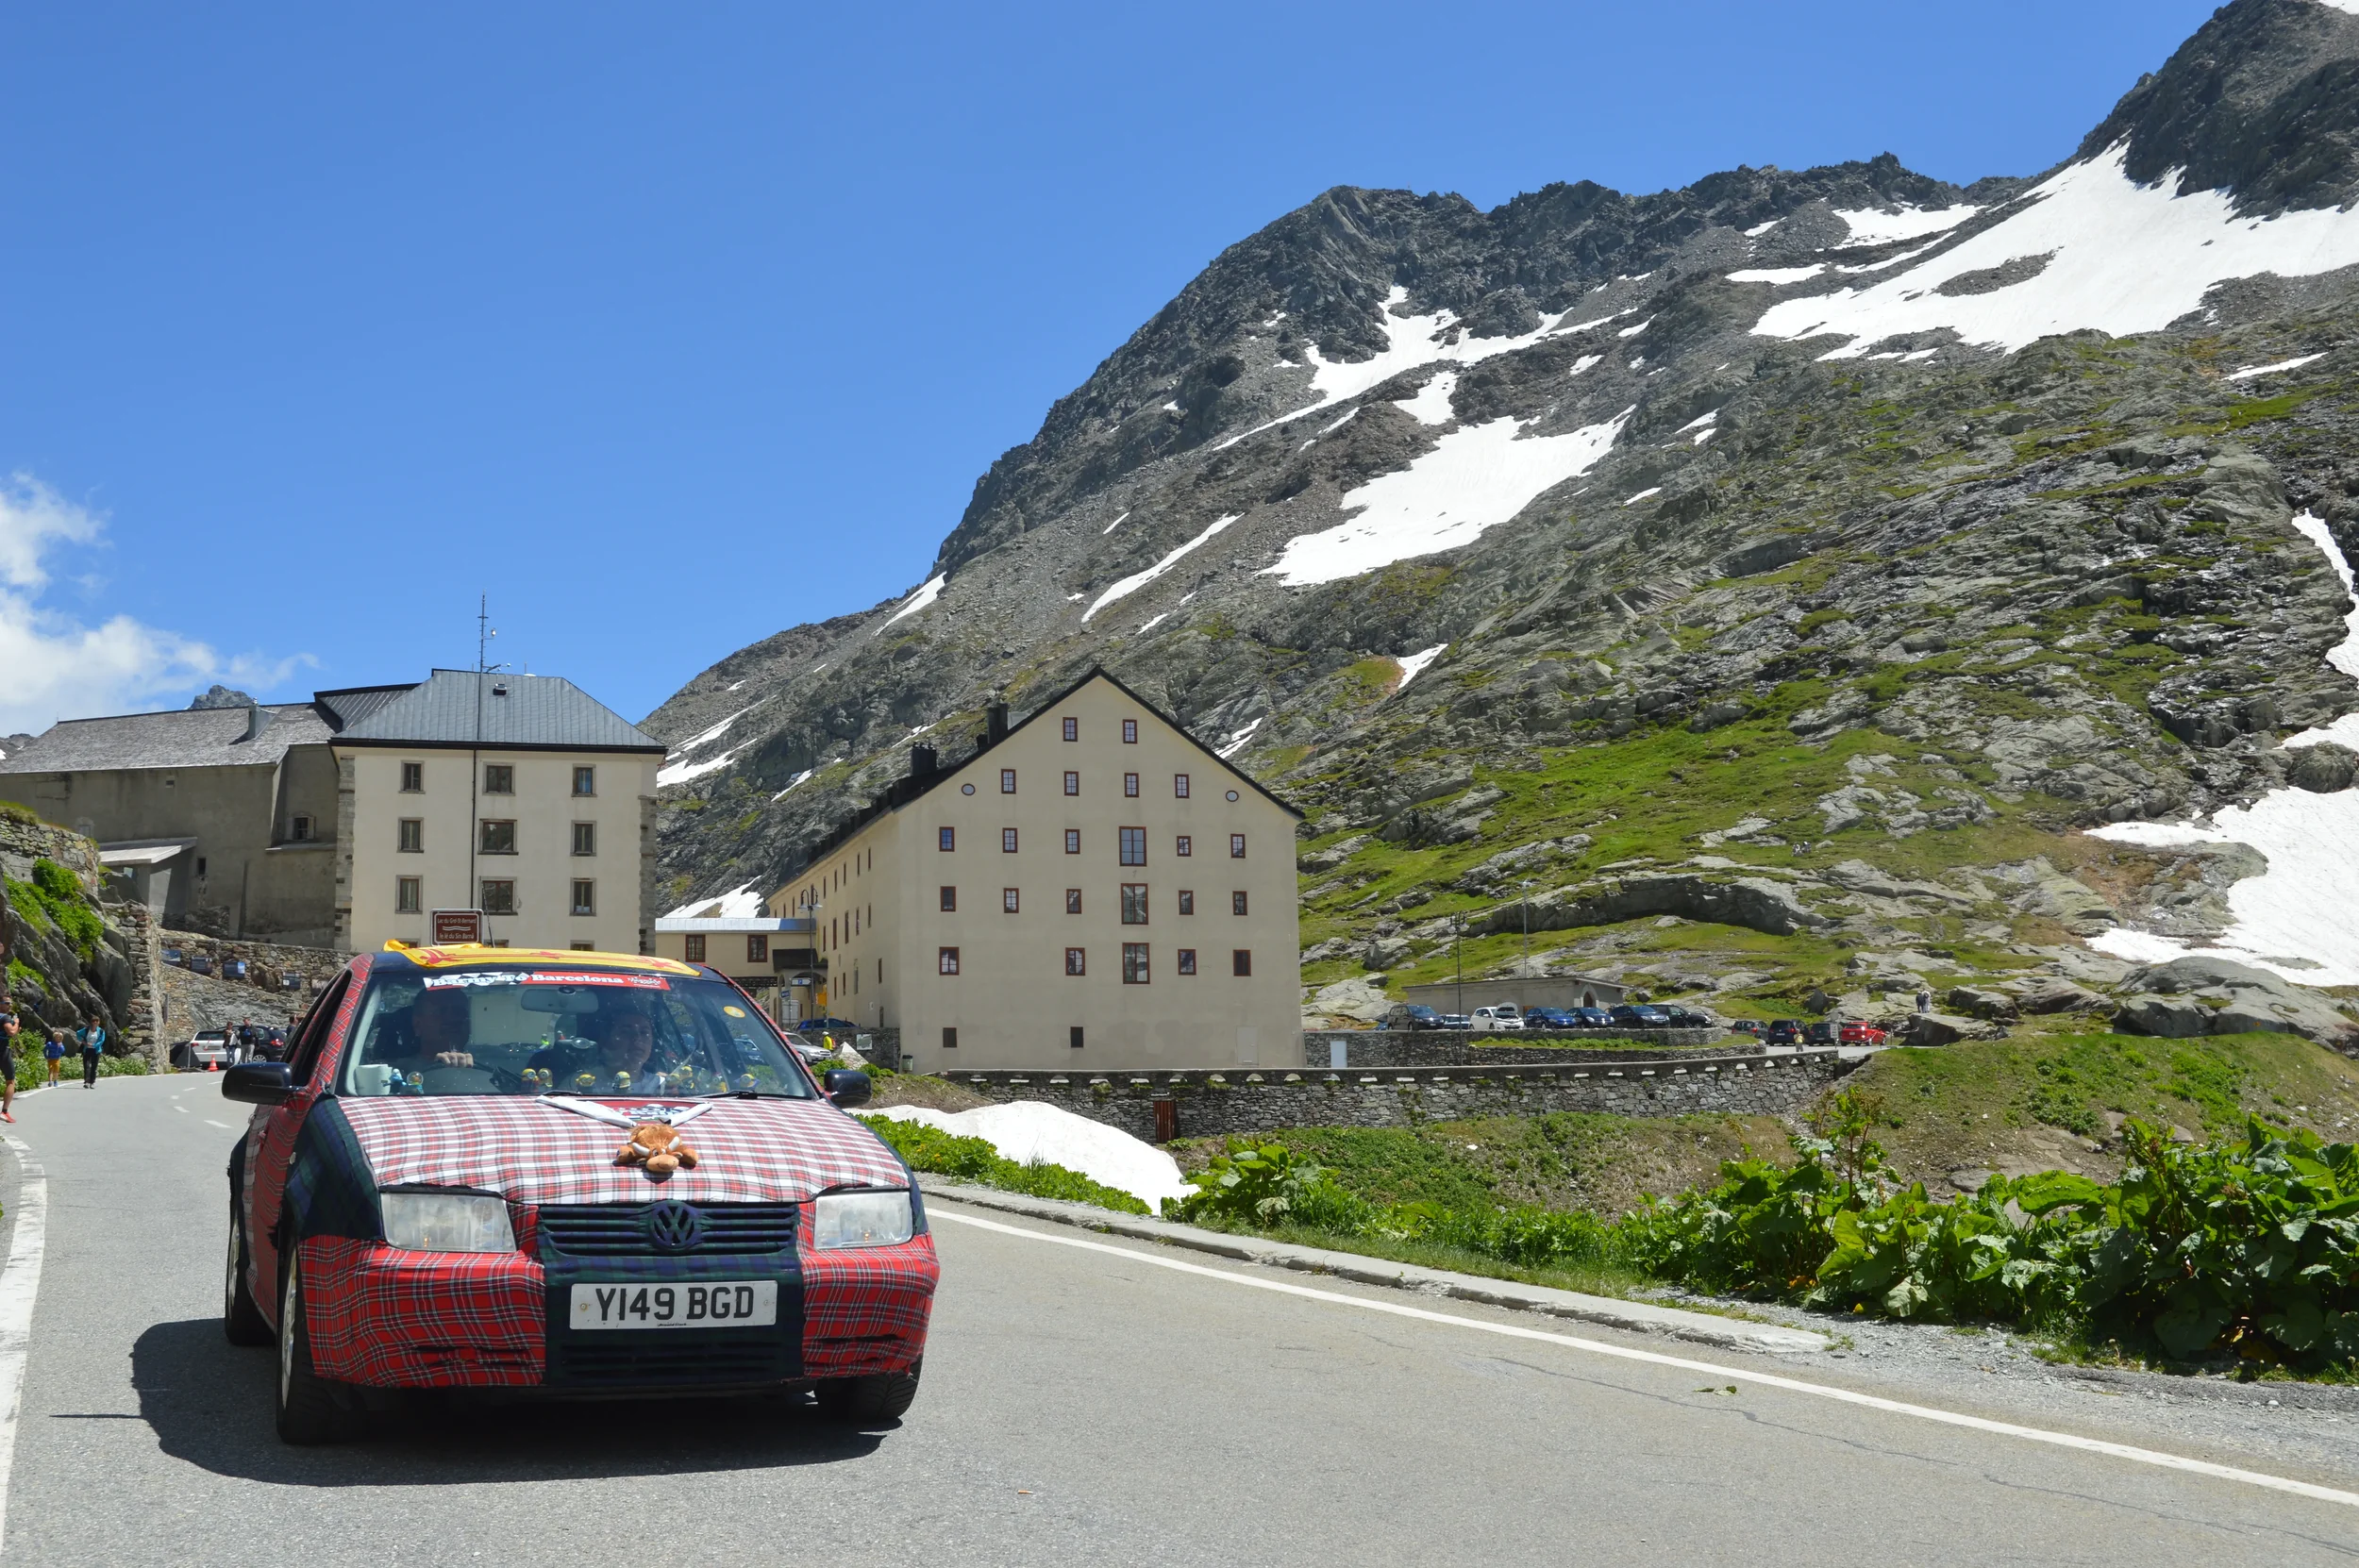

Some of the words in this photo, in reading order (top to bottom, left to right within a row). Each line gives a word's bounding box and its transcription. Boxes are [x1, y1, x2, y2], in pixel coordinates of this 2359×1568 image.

[530, 974, 624, 984] Barcelona
[595, 1287, 675, 1321] Y149
[686, 1286, 754, 1320] BGD
